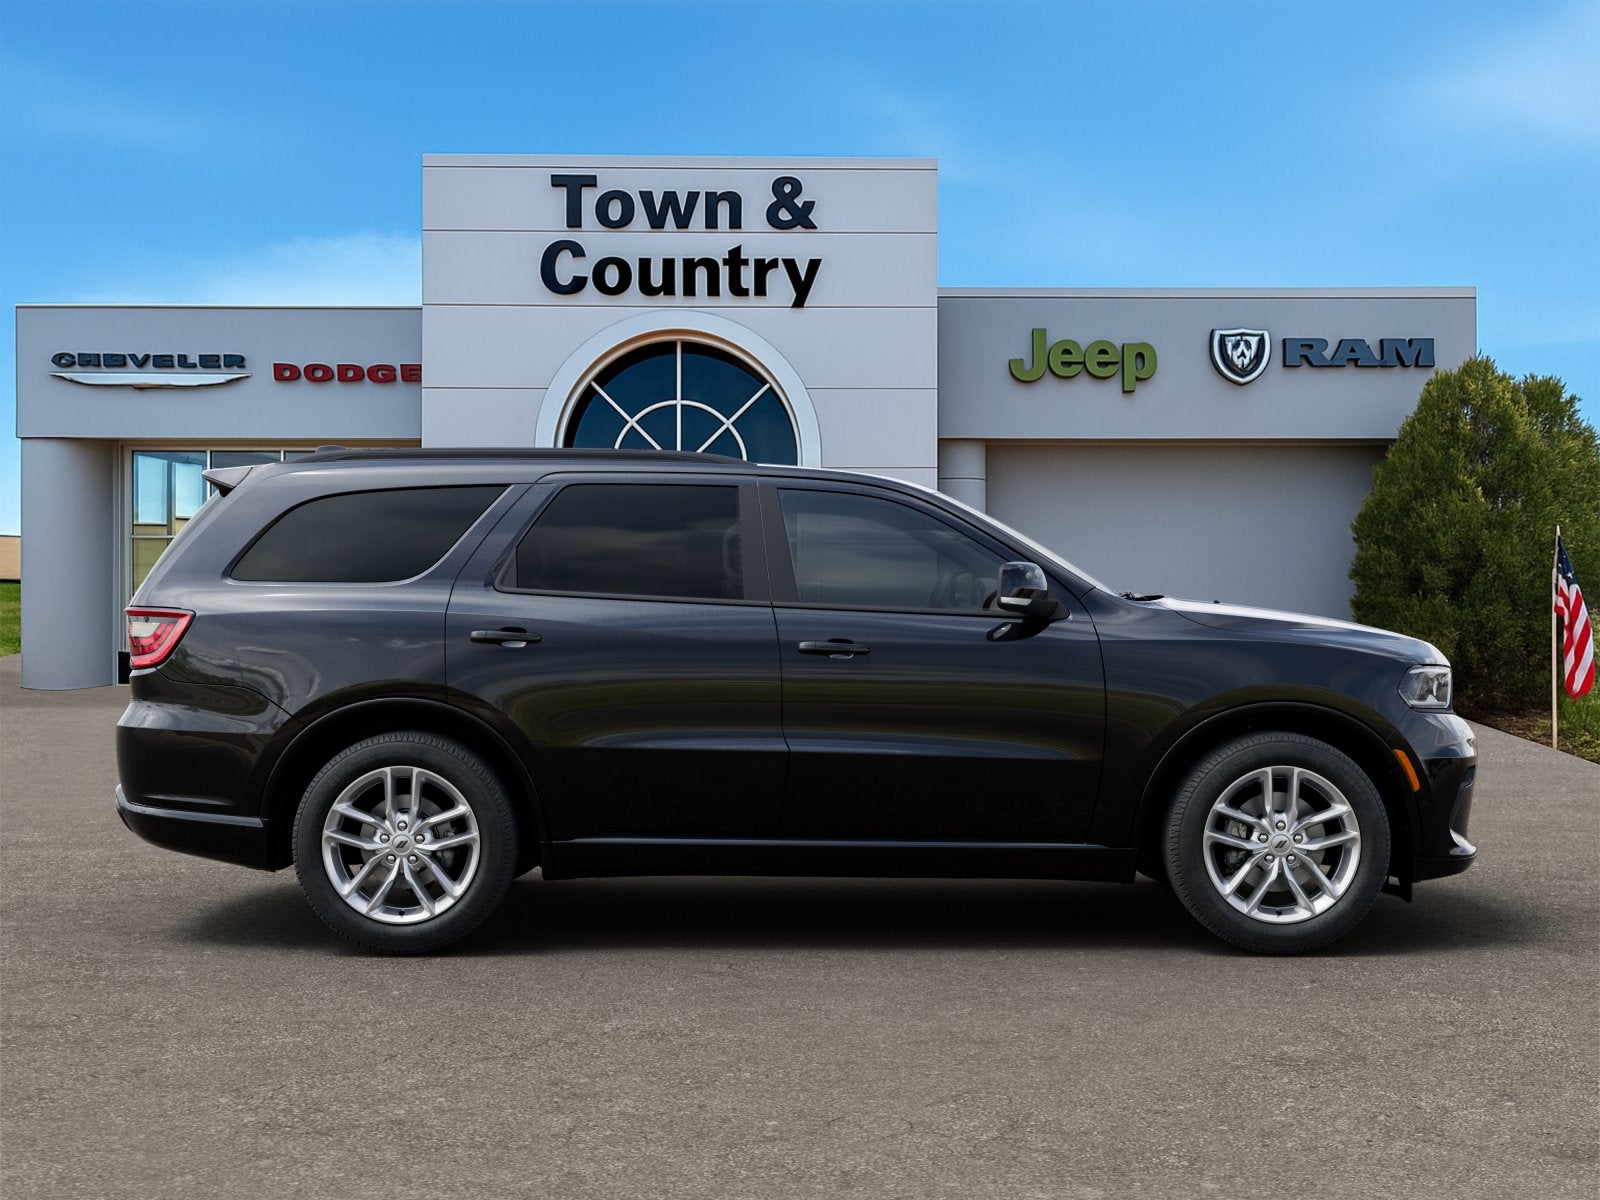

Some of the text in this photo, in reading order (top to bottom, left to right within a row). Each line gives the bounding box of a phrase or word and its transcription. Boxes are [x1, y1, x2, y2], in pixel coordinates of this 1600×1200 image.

[550, 174, 818, 230] Town &
[540, 239, 822, 308] Country
[273, 362, 422, 383] DODGE
[1008, 327, 1158, 393] Jeep
[1282, 337, 1436, 368] RAM
